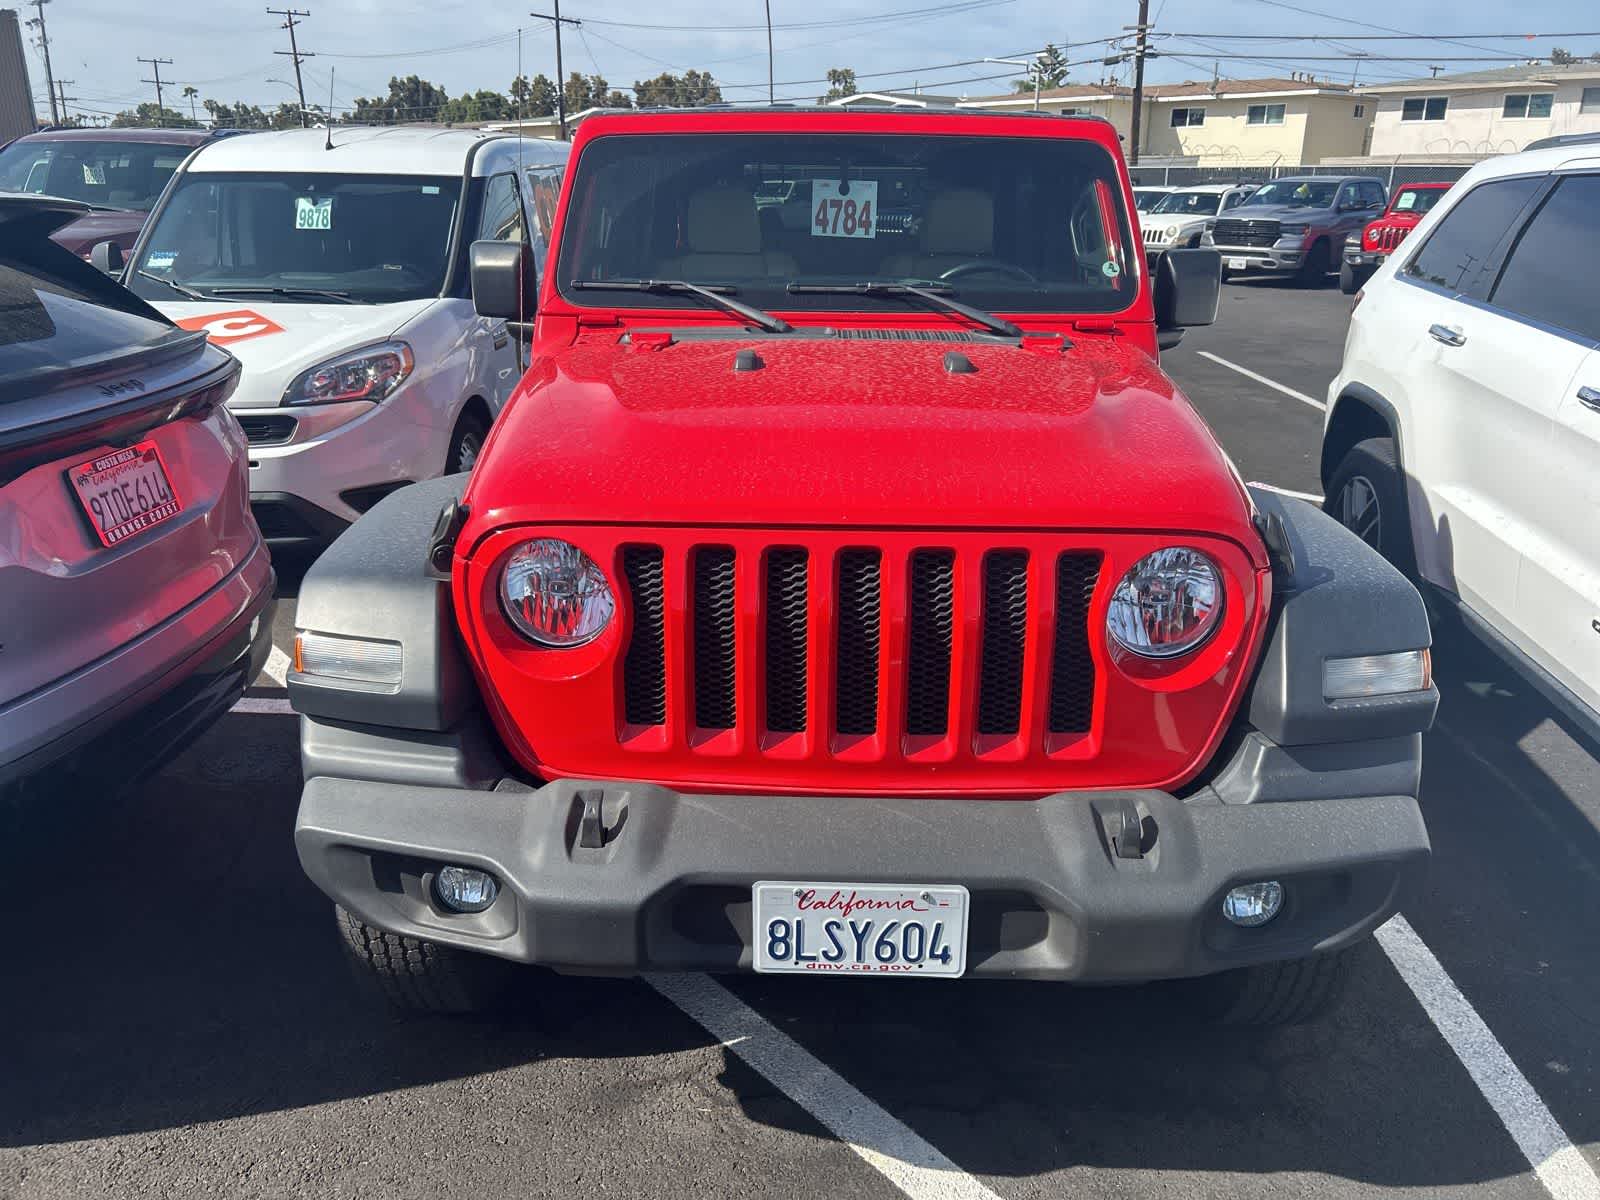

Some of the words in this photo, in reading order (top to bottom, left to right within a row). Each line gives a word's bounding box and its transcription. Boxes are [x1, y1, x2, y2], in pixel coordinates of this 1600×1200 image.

[299, 208, 329, 228] 9878
[815, 199, 872, 236] 4784
[96, 378, 146, 398] Jeep
[96, 456, 119, 472] COSTA
[107, 517, 147, 542] ORANGE
[149, 503, 178, 523] COAST
[798, 889, 929, 917] California
[767, 919, 951, 965] 8LSY604
[806, 963, 913, 972] dmv.ca.gov
